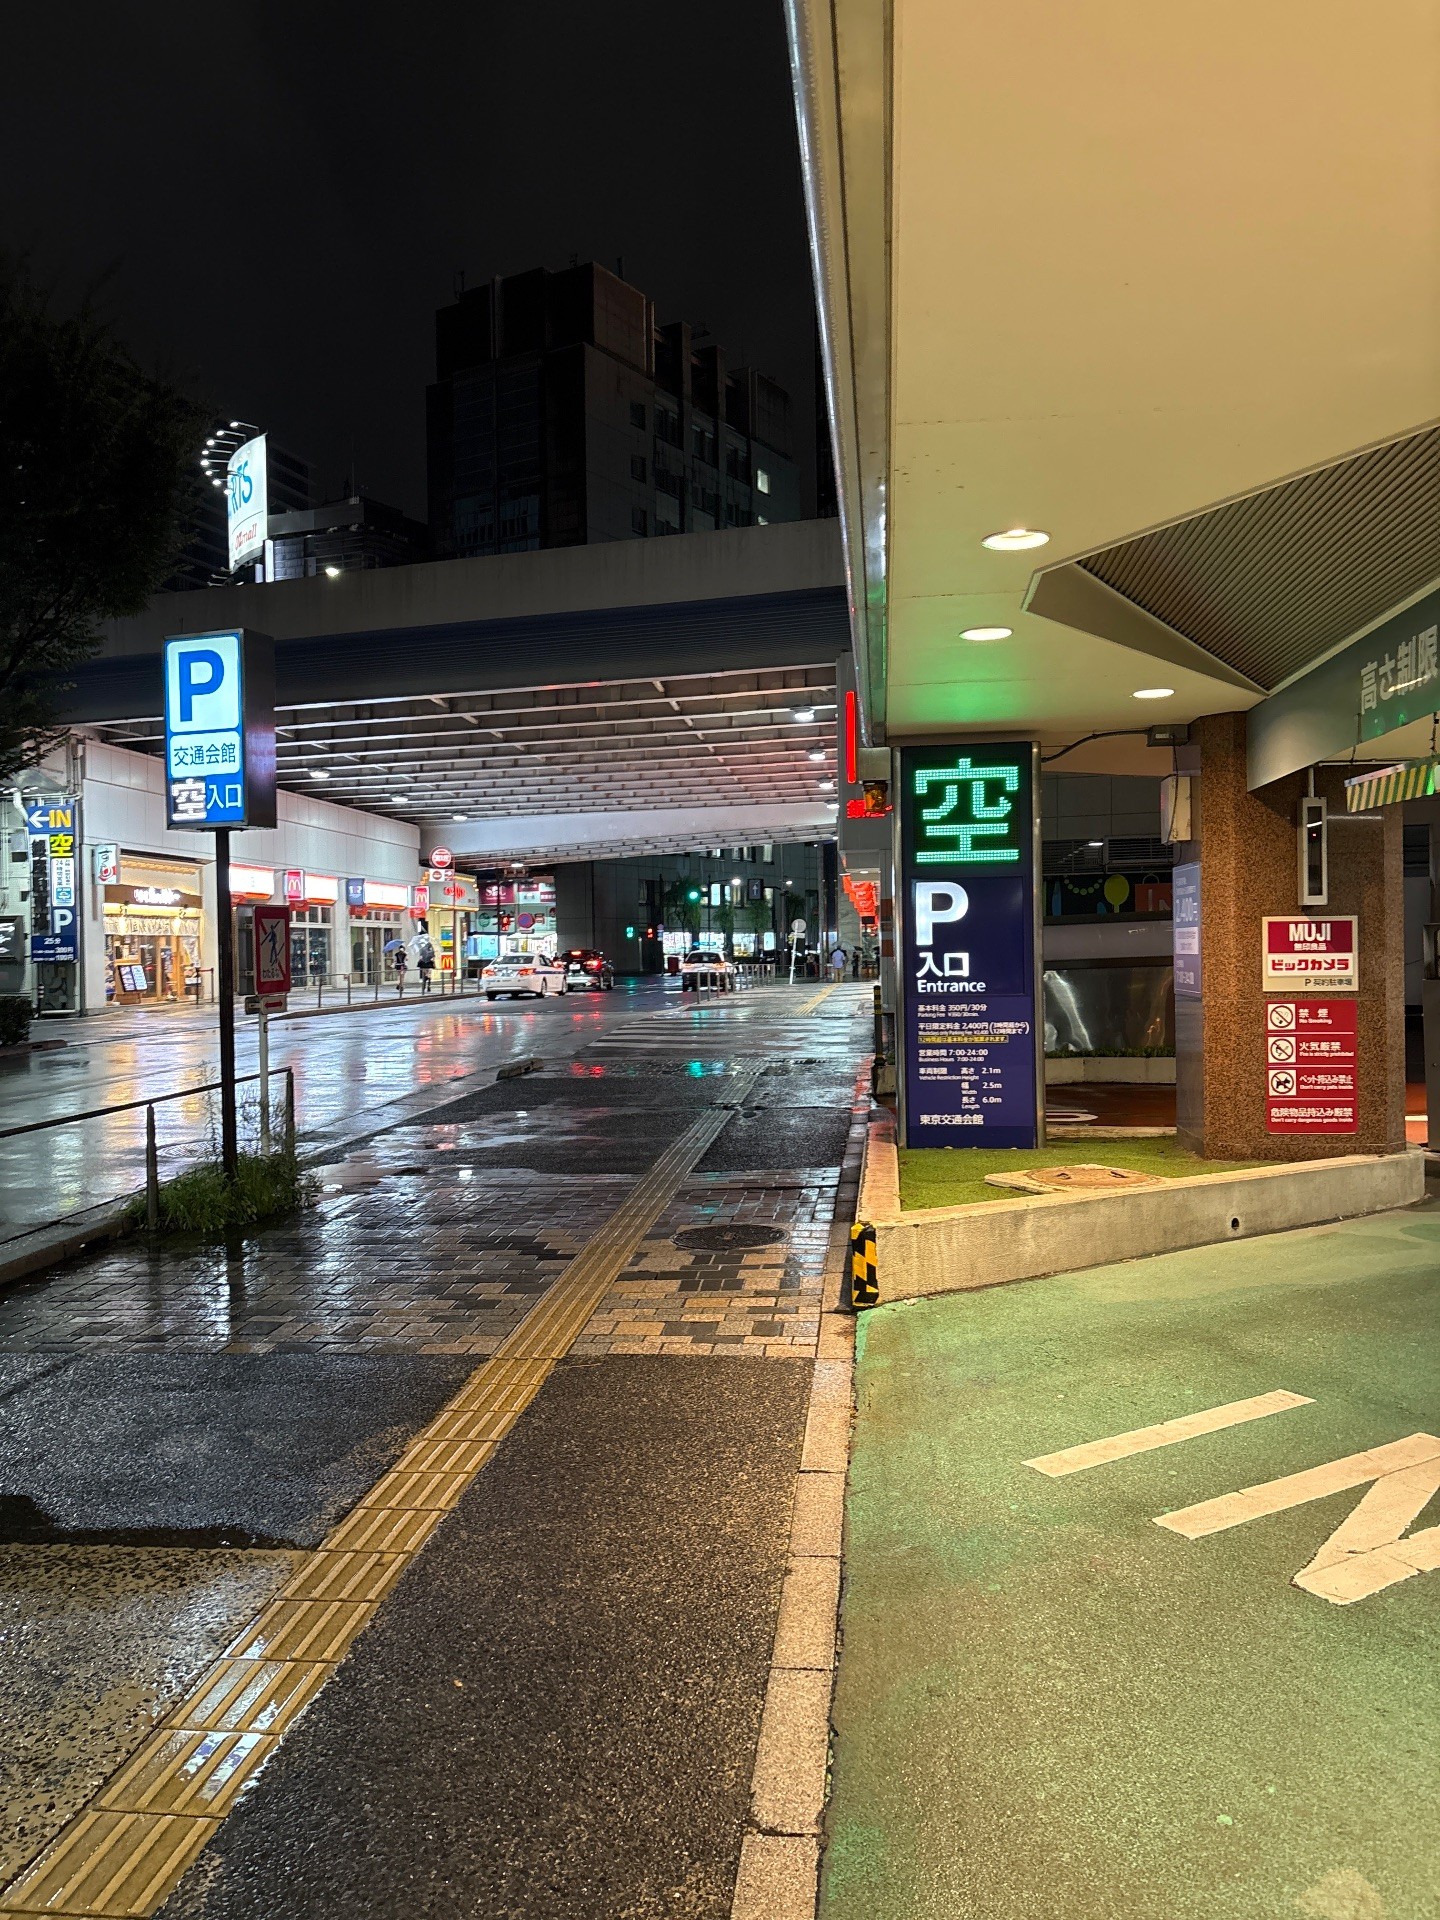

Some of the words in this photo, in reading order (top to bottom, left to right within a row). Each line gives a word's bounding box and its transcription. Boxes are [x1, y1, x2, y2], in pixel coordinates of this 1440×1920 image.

[1360, 624, 1438, 715] 高さ制限
[178, 649, 225, 722] P
[173, 742, 236, 767] 交通会館
[171, 778, 207, 821] 空
[206, 784, 242, 810] 入口
[49, 809, 71, 828] IN
[915, 758, 1019, 863] 空
[50, 833, 73, 857] 空
[53, 909, 73, 934] P
[916, 881, 969, 946] P
[1288, 923, 1332, 941] MUJI
[916, 952, 970, 977] 入口
[1271, 958, 1350, 971] ビックカメラ
[917, 979, 986, 993] Entrance
[1304, 978, 1312, 987] P
[917, 1004, 946, 1012] 基本料金
[948, 1048, 989, 1056] 7:00-24:00
[1299, 1041, 1341, 1051] 火気厳禁
[960, 1067, 975, 1075] 高さ
[961, 1096, 976, 1104] 長さ
[982, 1096, 1003, 1104] 6.0m
[919, 1114, 984, 1125] 東京交通会館
